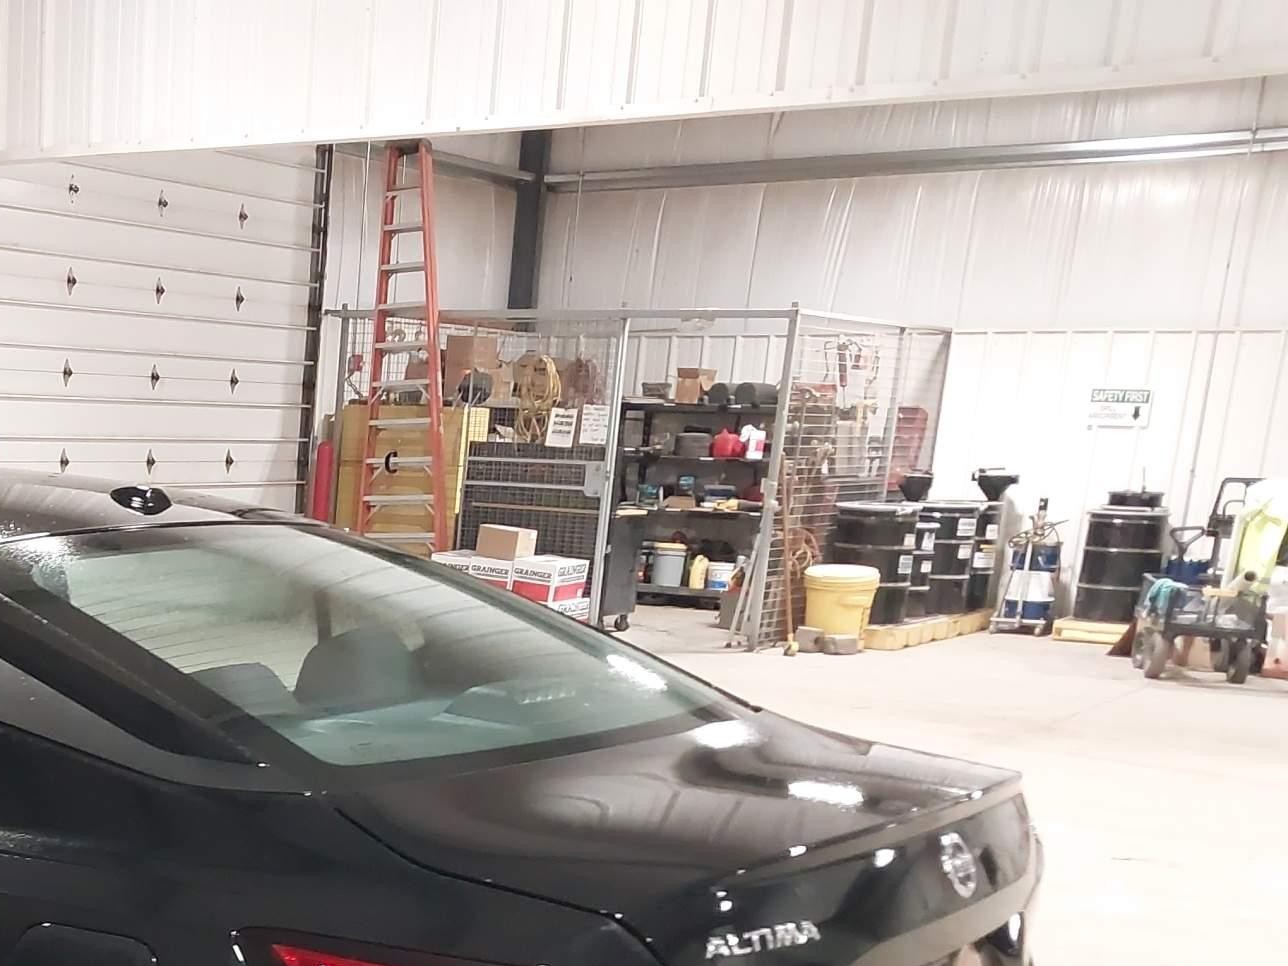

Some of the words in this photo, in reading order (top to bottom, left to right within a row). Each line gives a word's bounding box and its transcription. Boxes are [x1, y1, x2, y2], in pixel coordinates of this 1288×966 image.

[1092, 390, 1125, 402] SAFETY
[1125, 390, 1150, 402] FIRST
[470, 564, 509, 576] GRAINGER
[513, 567, 552, 579] GRAINGER
[705, 921, 821, 959] ALTIMA
